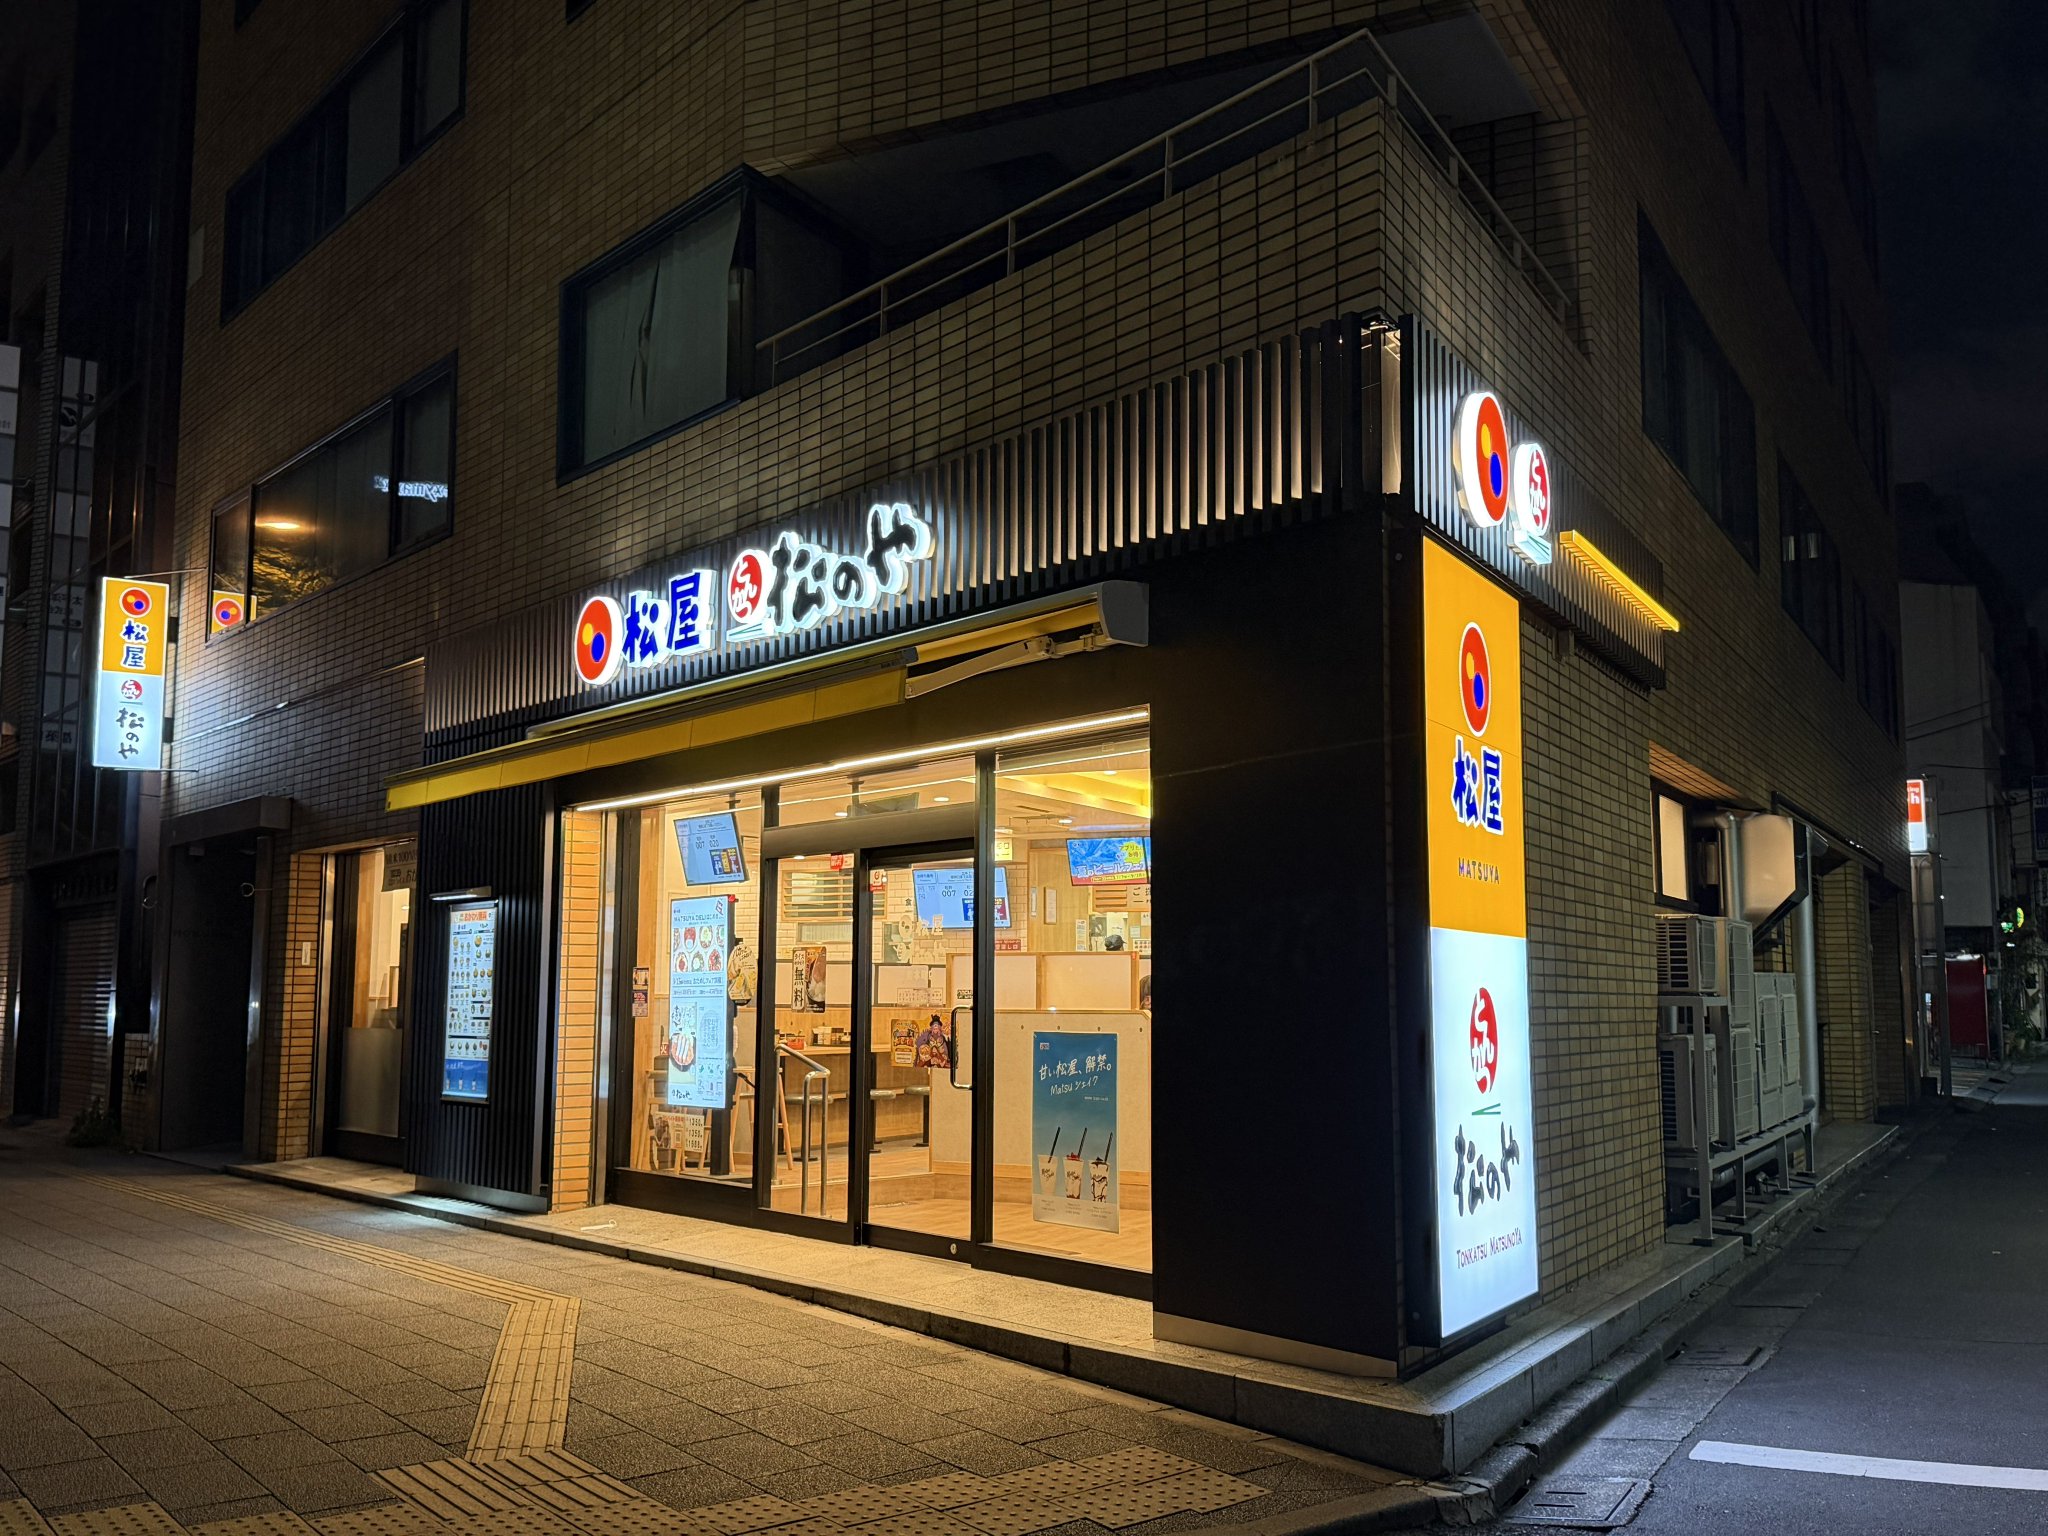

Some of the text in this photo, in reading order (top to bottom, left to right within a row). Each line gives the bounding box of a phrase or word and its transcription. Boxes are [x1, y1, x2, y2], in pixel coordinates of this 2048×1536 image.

[766, 508, 918, 627] 松のや
[621, 570, 702, 665] 松屋
[121, 619, 150, 669] 松屋
[115, 707, 146, 760] 松のや
[1454, 738, 1503, 831] 松屋
[941, 889, 956, 898] 007
[1458, 857, 1501, 886] MATSUYA
[794, 967, 804, 1007] 無料
[1050, 1076, 1099, 1096] Matsu シェイク
[1452, 1120, 1521, 1218] 松のや
[1456, 1229, 1523, 1270] TONKATSU MATSUNOYA
